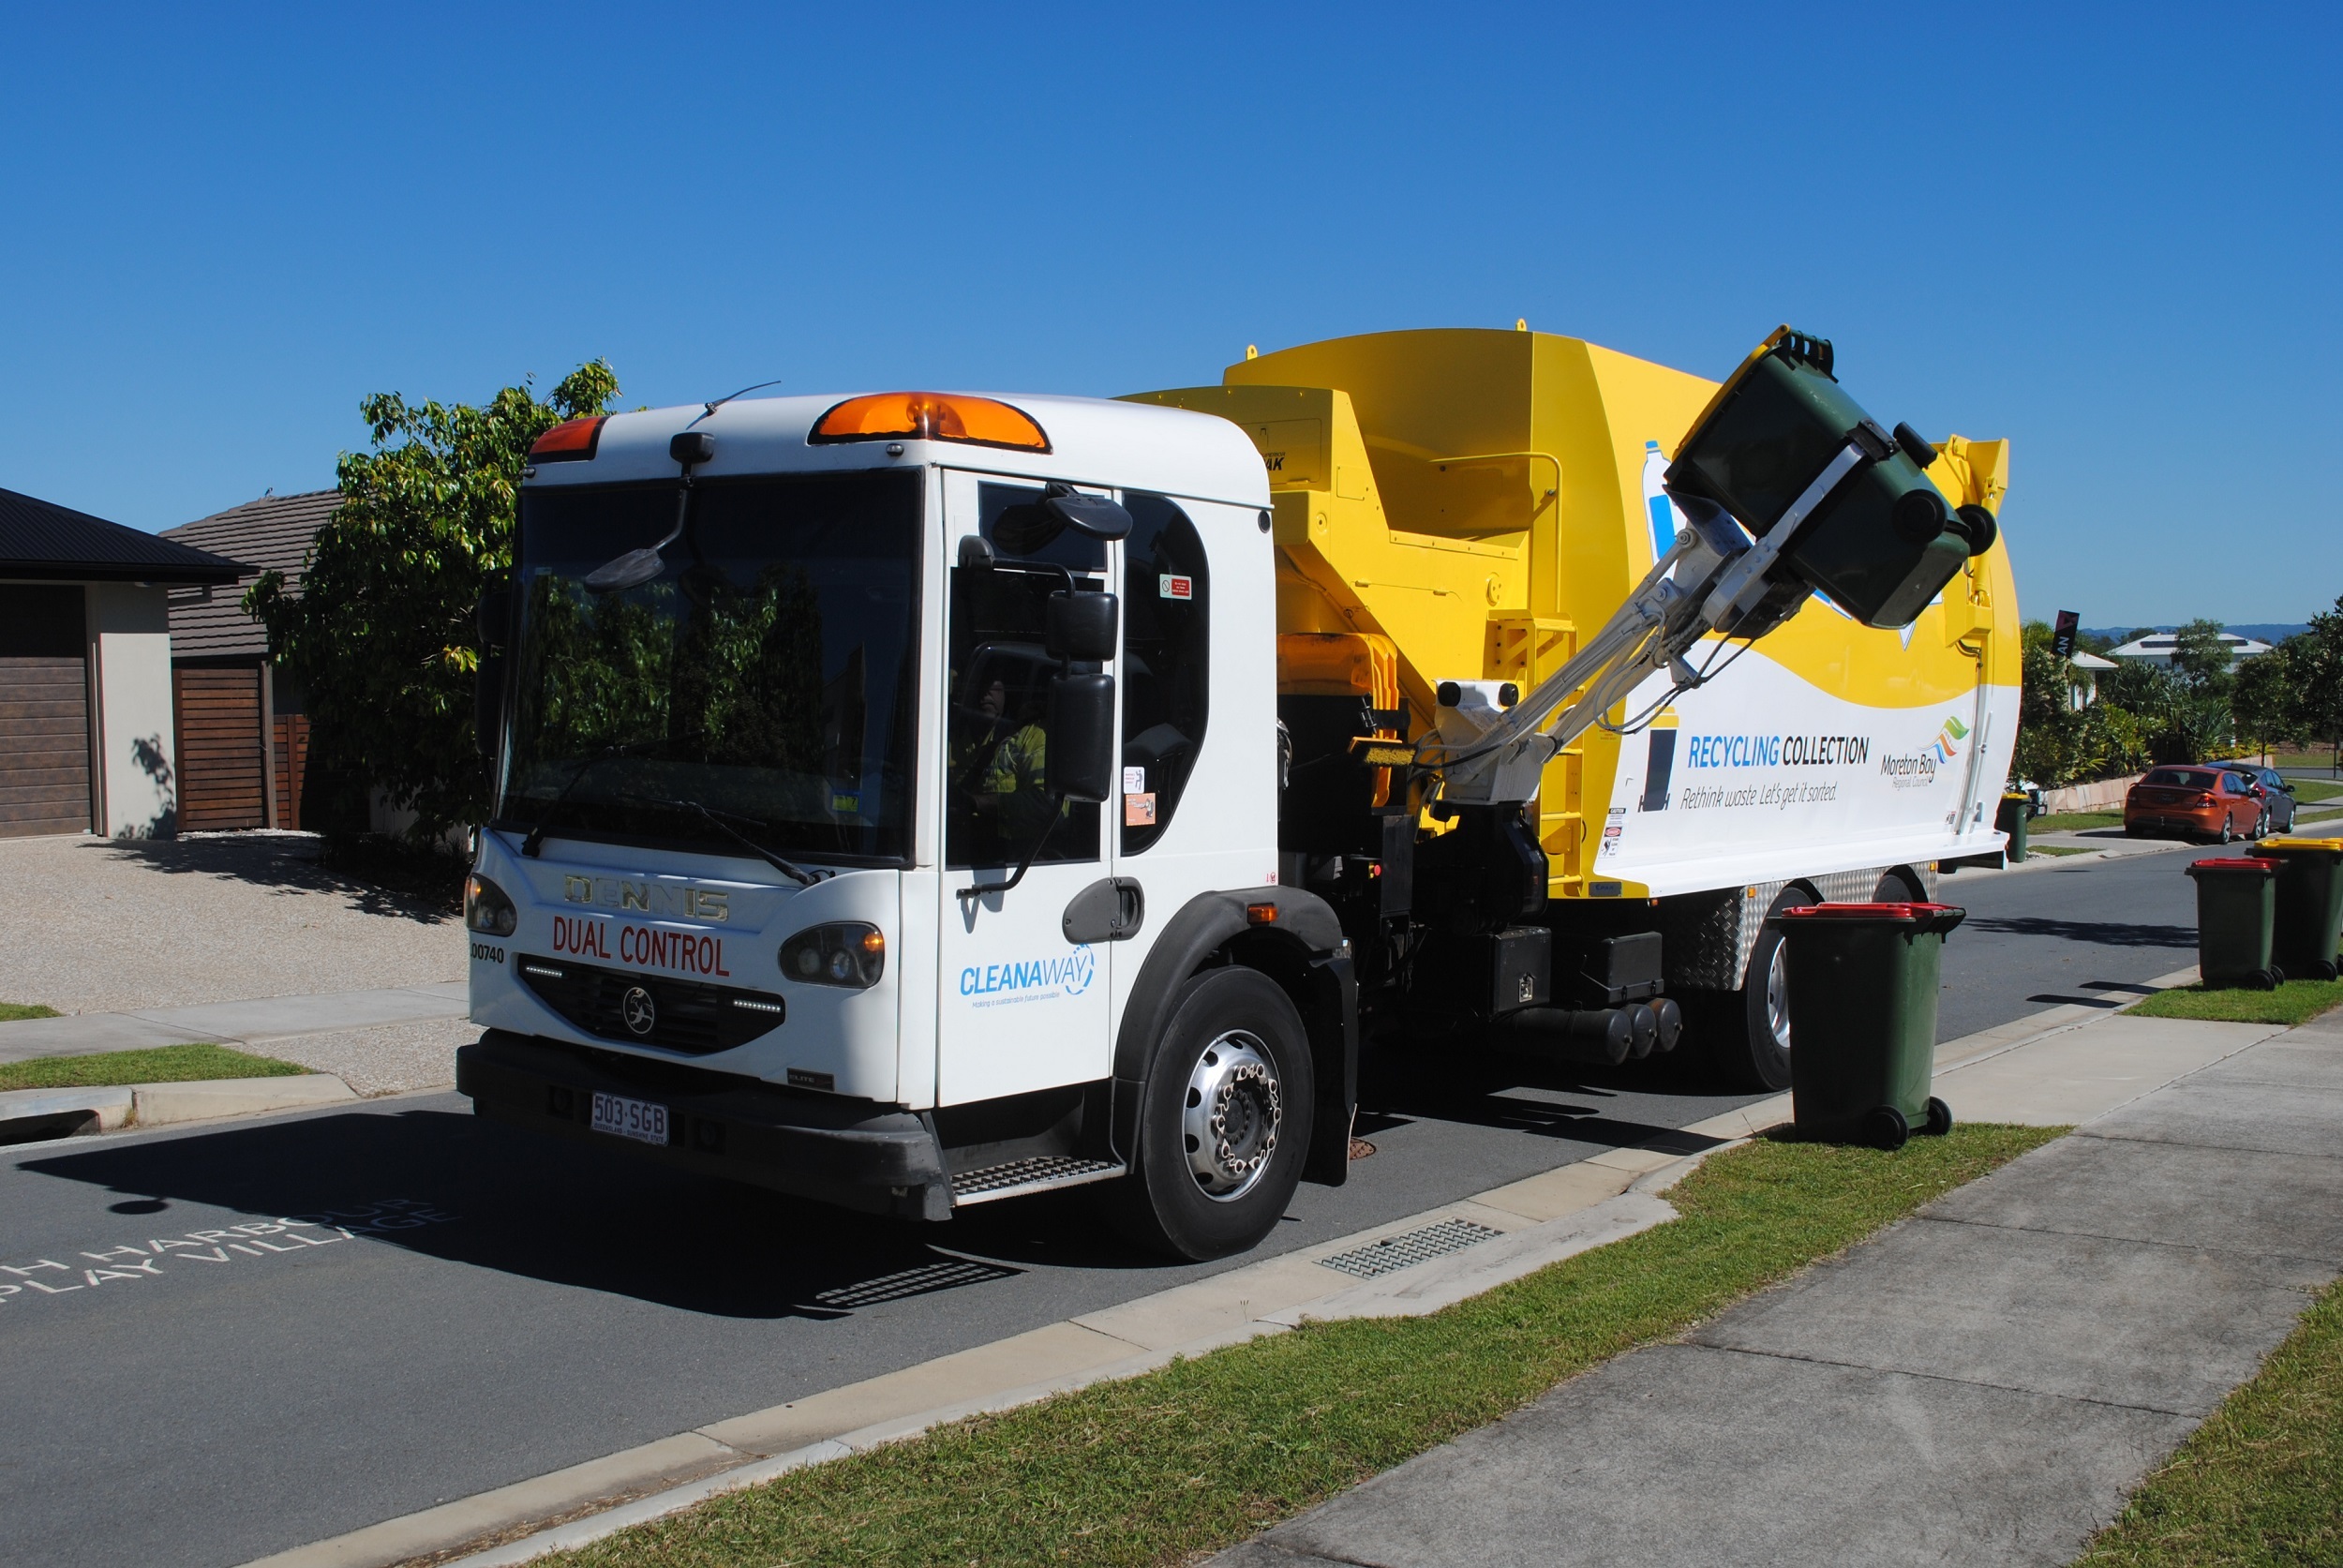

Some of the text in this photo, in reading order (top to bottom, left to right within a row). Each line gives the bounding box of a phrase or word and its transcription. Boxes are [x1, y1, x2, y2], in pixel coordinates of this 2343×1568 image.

[1265, 456, 1285, 470] AK
[1687, 735, 1870, 769] RECYCLING COLLECTION
[1880, 754, 1937, 784] Moreton Bay
[1892, 776, 1928, 791] Regional Council
[1680, 781, 1838, 811] Rethink waste Let's get it sorted.
[564, 874, 729, 923] DENNIS
[553, 916, 730, 978] DUAL CONTROL
[960, 954, 1088, 996] CLEANAWAY
[972, 999, 991, 1008] Making
[995, 995, 1024, 1006] sustainable
[1023, 993, 1039, 1004] future
[1039, 991, 1060, 1001] possible
[593, 1122, 623, 1135] QUEENSLAND
[626, 1128, 649, 1140] SUNSHINE
[649, 1134, 664, 1143] STATE
[174, 1208, 464, 1262] VILLAGE
